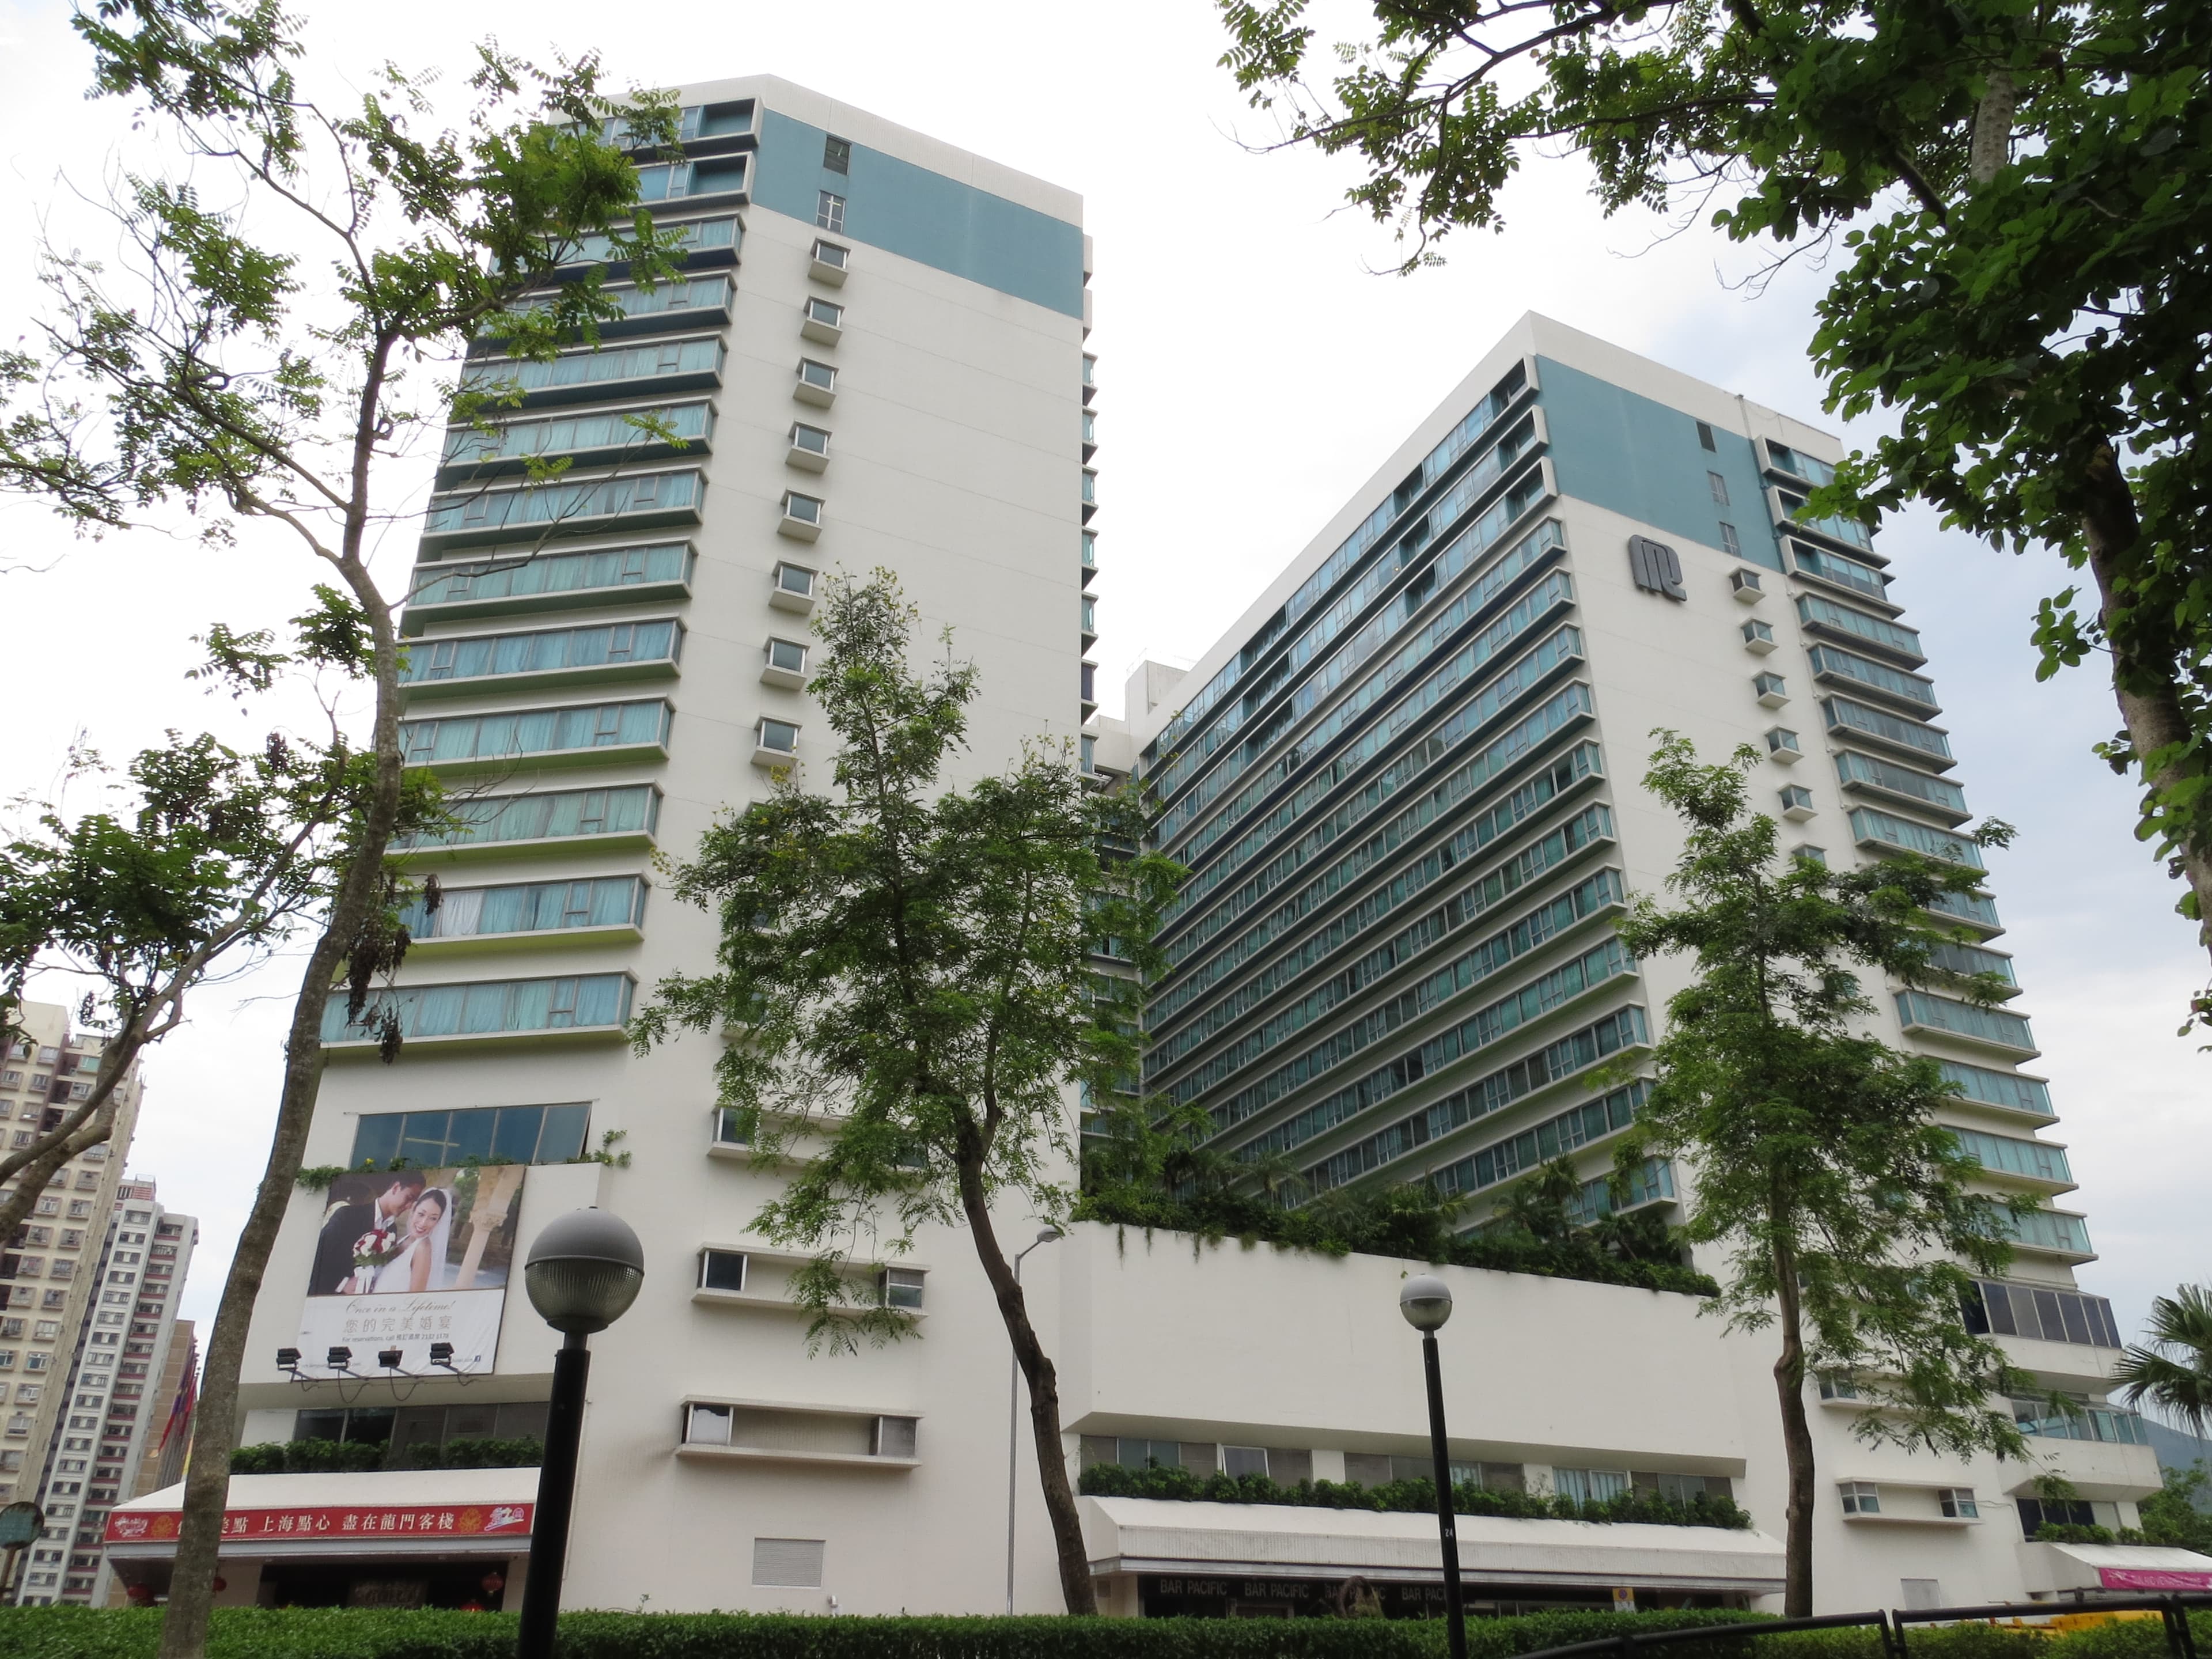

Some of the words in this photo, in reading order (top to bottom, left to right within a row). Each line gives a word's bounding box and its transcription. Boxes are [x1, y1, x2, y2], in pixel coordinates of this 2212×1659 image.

[346, 1297, 372, 1314] Once
[374, 1305, 387, 1313] in
[344, 1316, 452, 1334] 您的完美婚宴
[259, 1514, 331, 1532] 上海點心
[342, 1512, 454, 1531] 盡在龍門客棧
[1160, 1579, 1183, 1594] BAR
[1187, 1580, 1228, 1596] PACIFIC
[1244, 1582, 1267, 1597] BAR
[1270, 1583, 1309, 1598] PACIFIC
[1402, 1586, 1422, 1600] BAR
